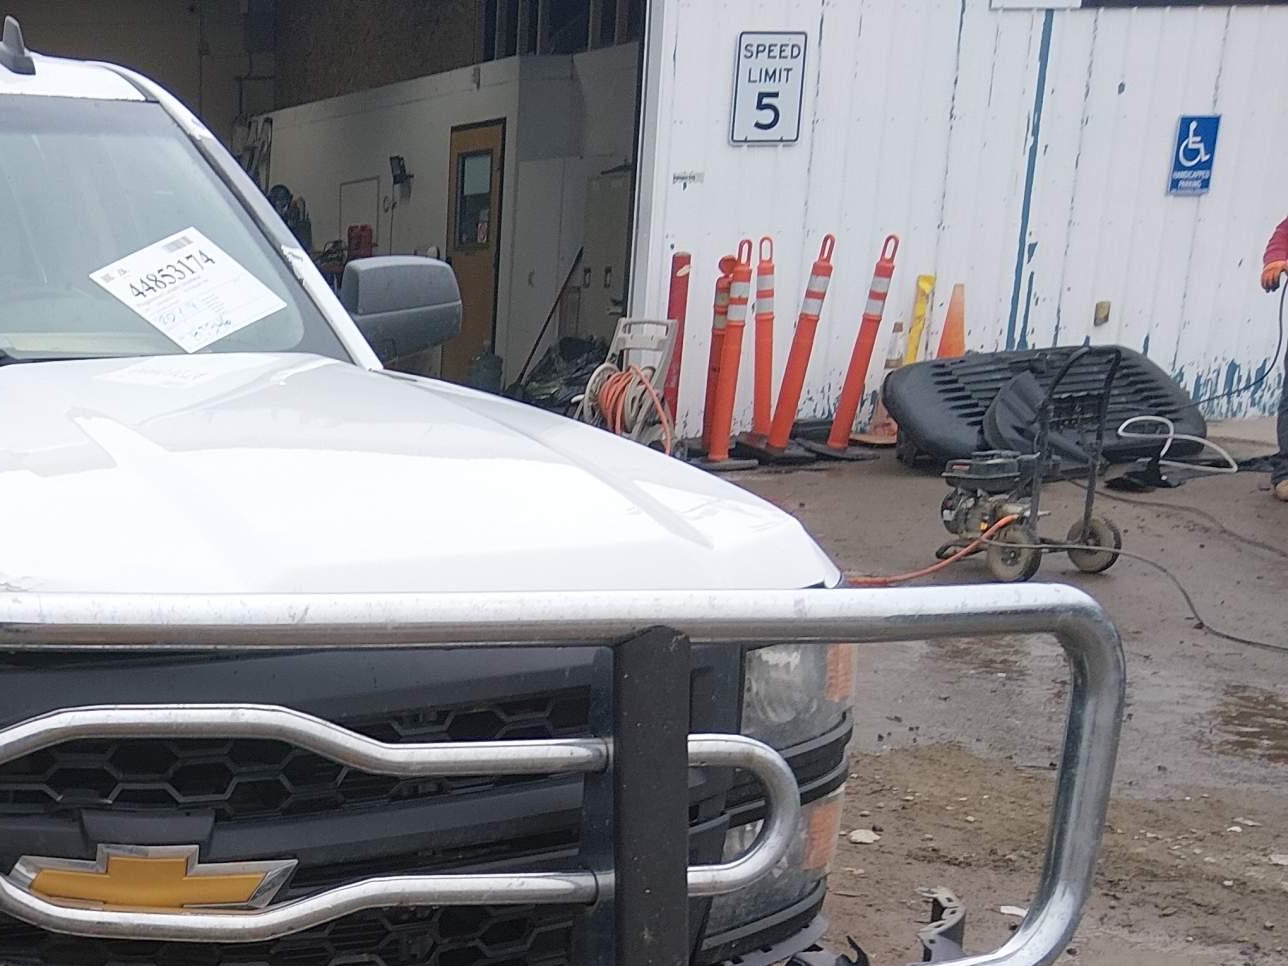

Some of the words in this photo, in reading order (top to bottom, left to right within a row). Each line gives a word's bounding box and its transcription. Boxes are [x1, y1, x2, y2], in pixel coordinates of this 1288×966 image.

[744, 43, 801, 59] SPEED
[747, 67, 793, 84] LIMIT
[753, 91, 780, 131] 5
[128, 250, 216, 299] 44853174
